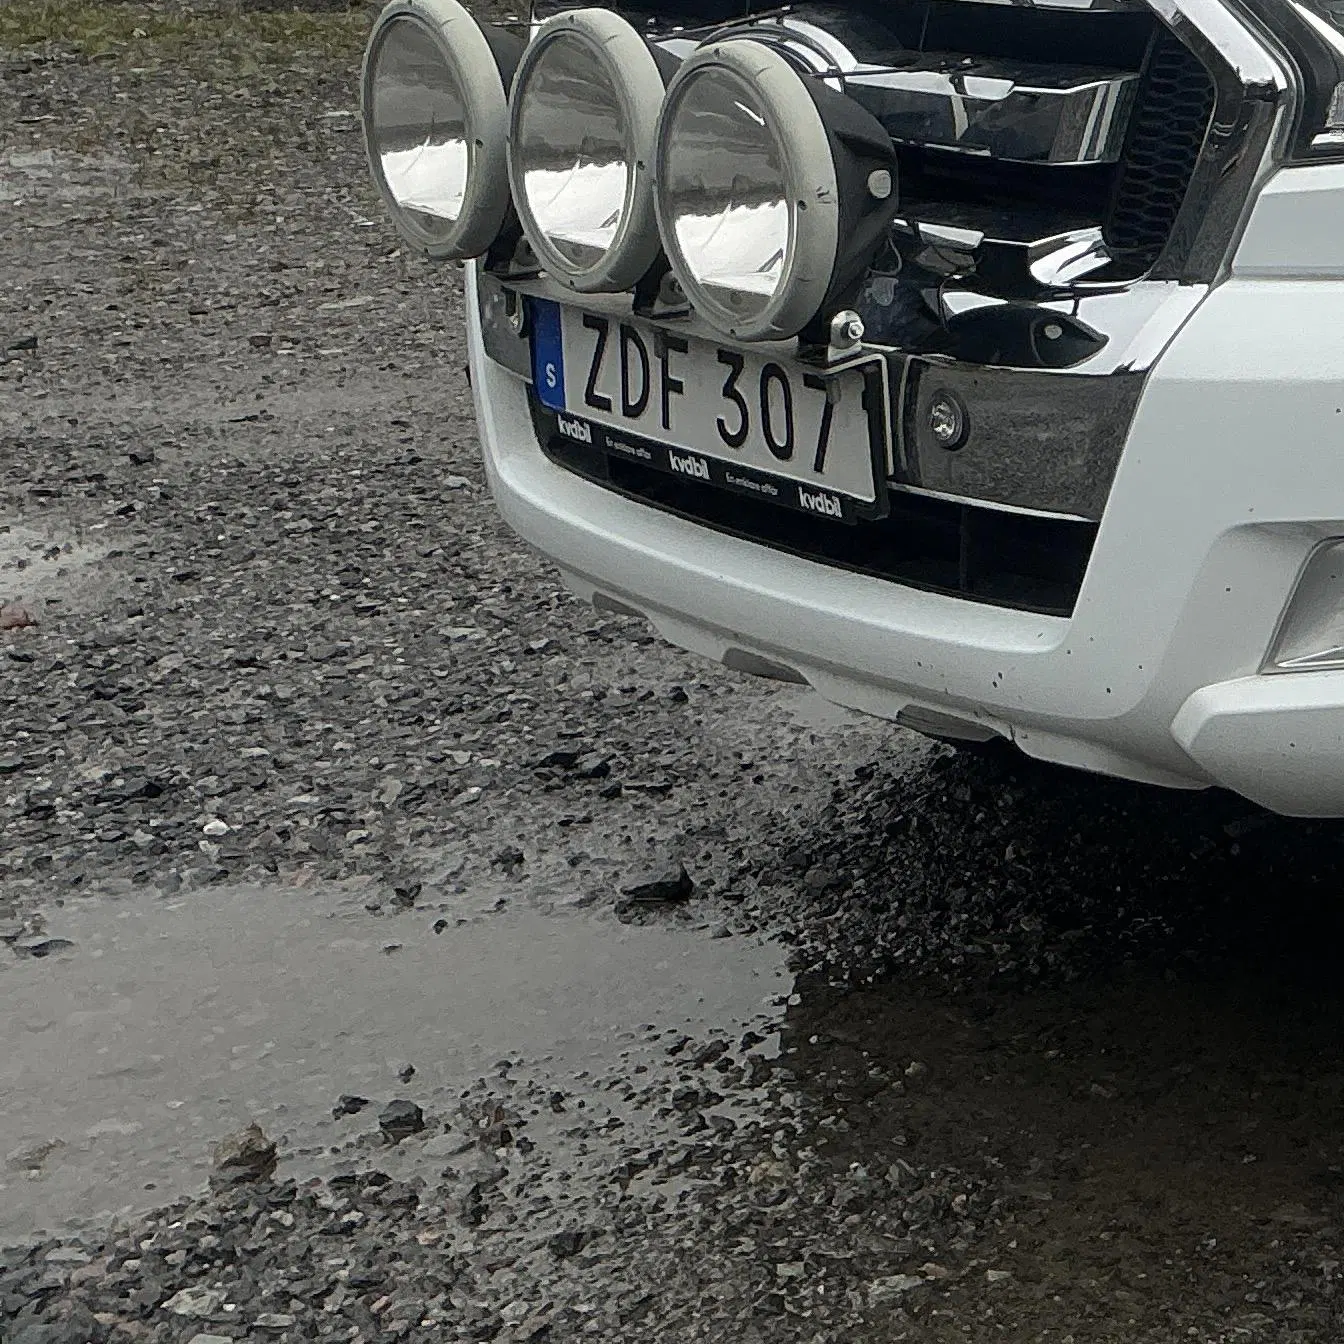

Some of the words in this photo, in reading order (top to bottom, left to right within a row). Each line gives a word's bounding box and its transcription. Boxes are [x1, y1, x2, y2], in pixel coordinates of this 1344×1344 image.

[545, 362, 557, 389] S
[582, 312, 689, 430] ZDF
[716, 347, 838, 474] 307
